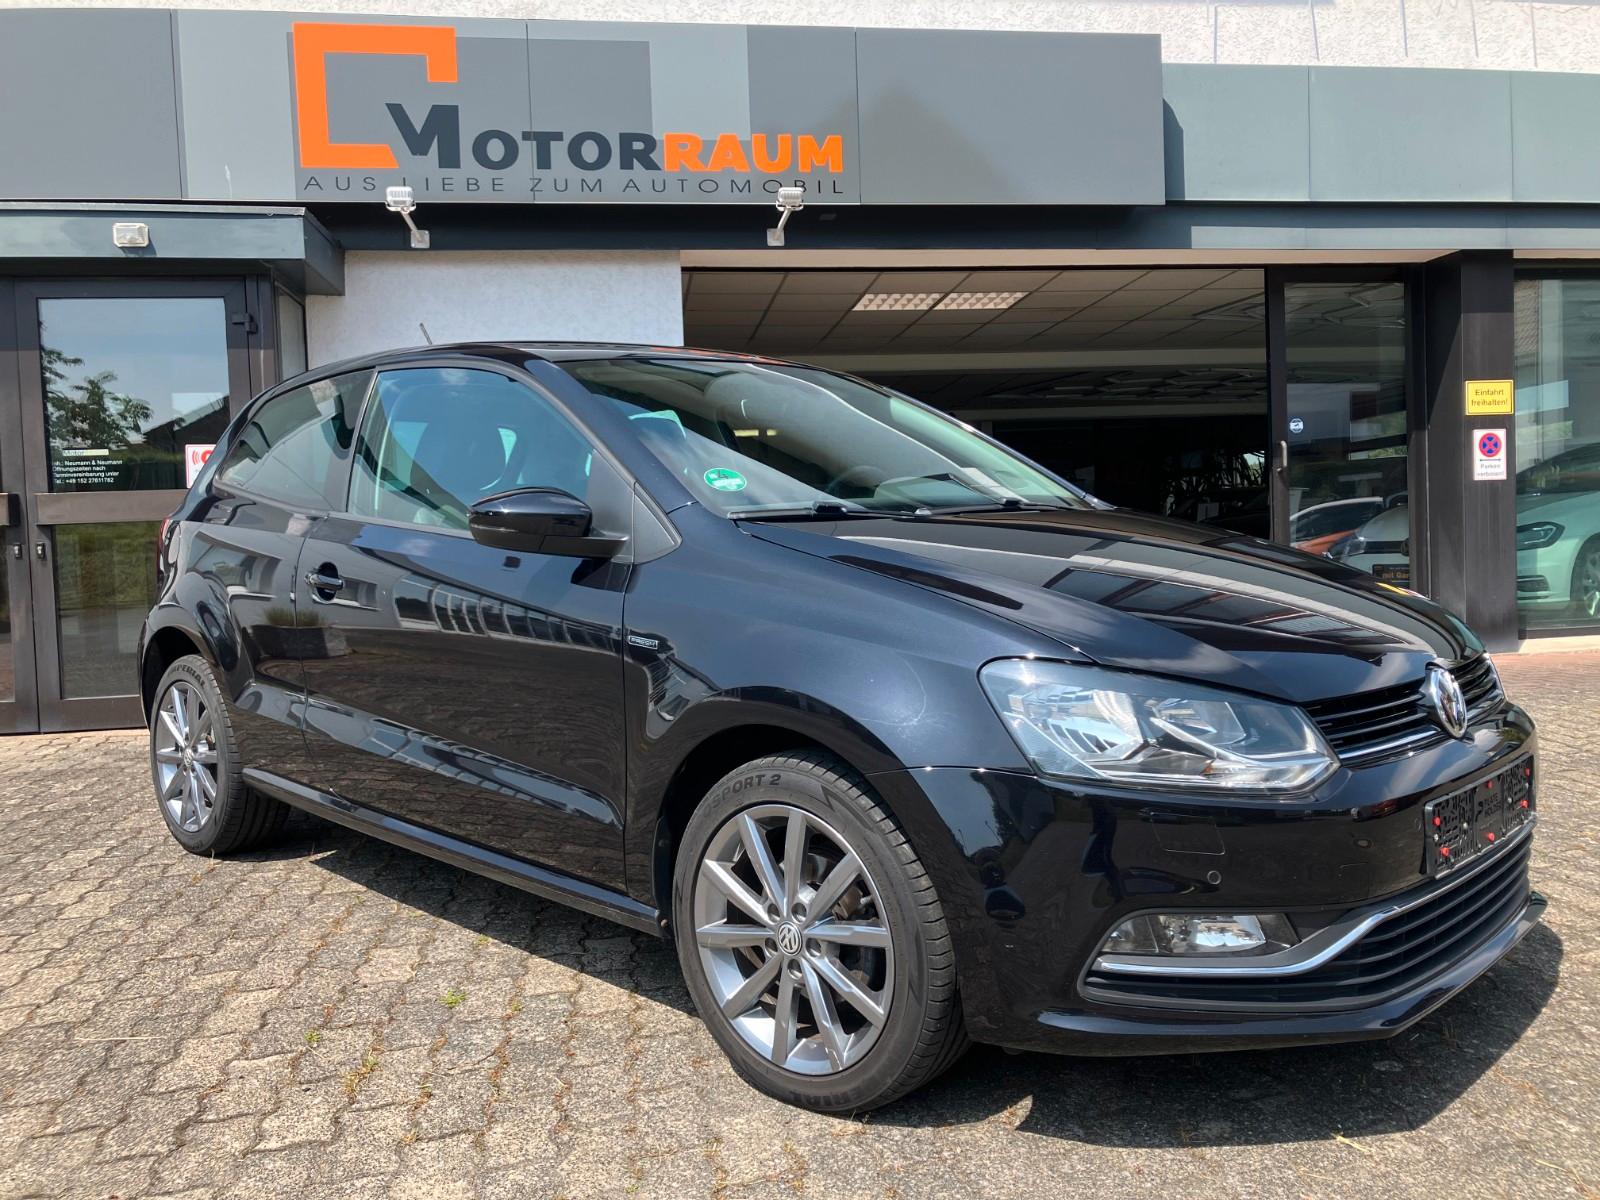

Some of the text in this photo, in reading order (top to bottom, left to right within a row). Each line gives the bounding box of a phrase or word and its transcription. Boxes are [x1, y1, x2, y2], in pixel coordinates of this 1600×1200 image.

[304, 176, 377, 192] AUS
[529, 177, 602, 193] ZUM
[622, 178, 844, 194] AUTOMOBIL
[769, 774, 782, 786] 2
